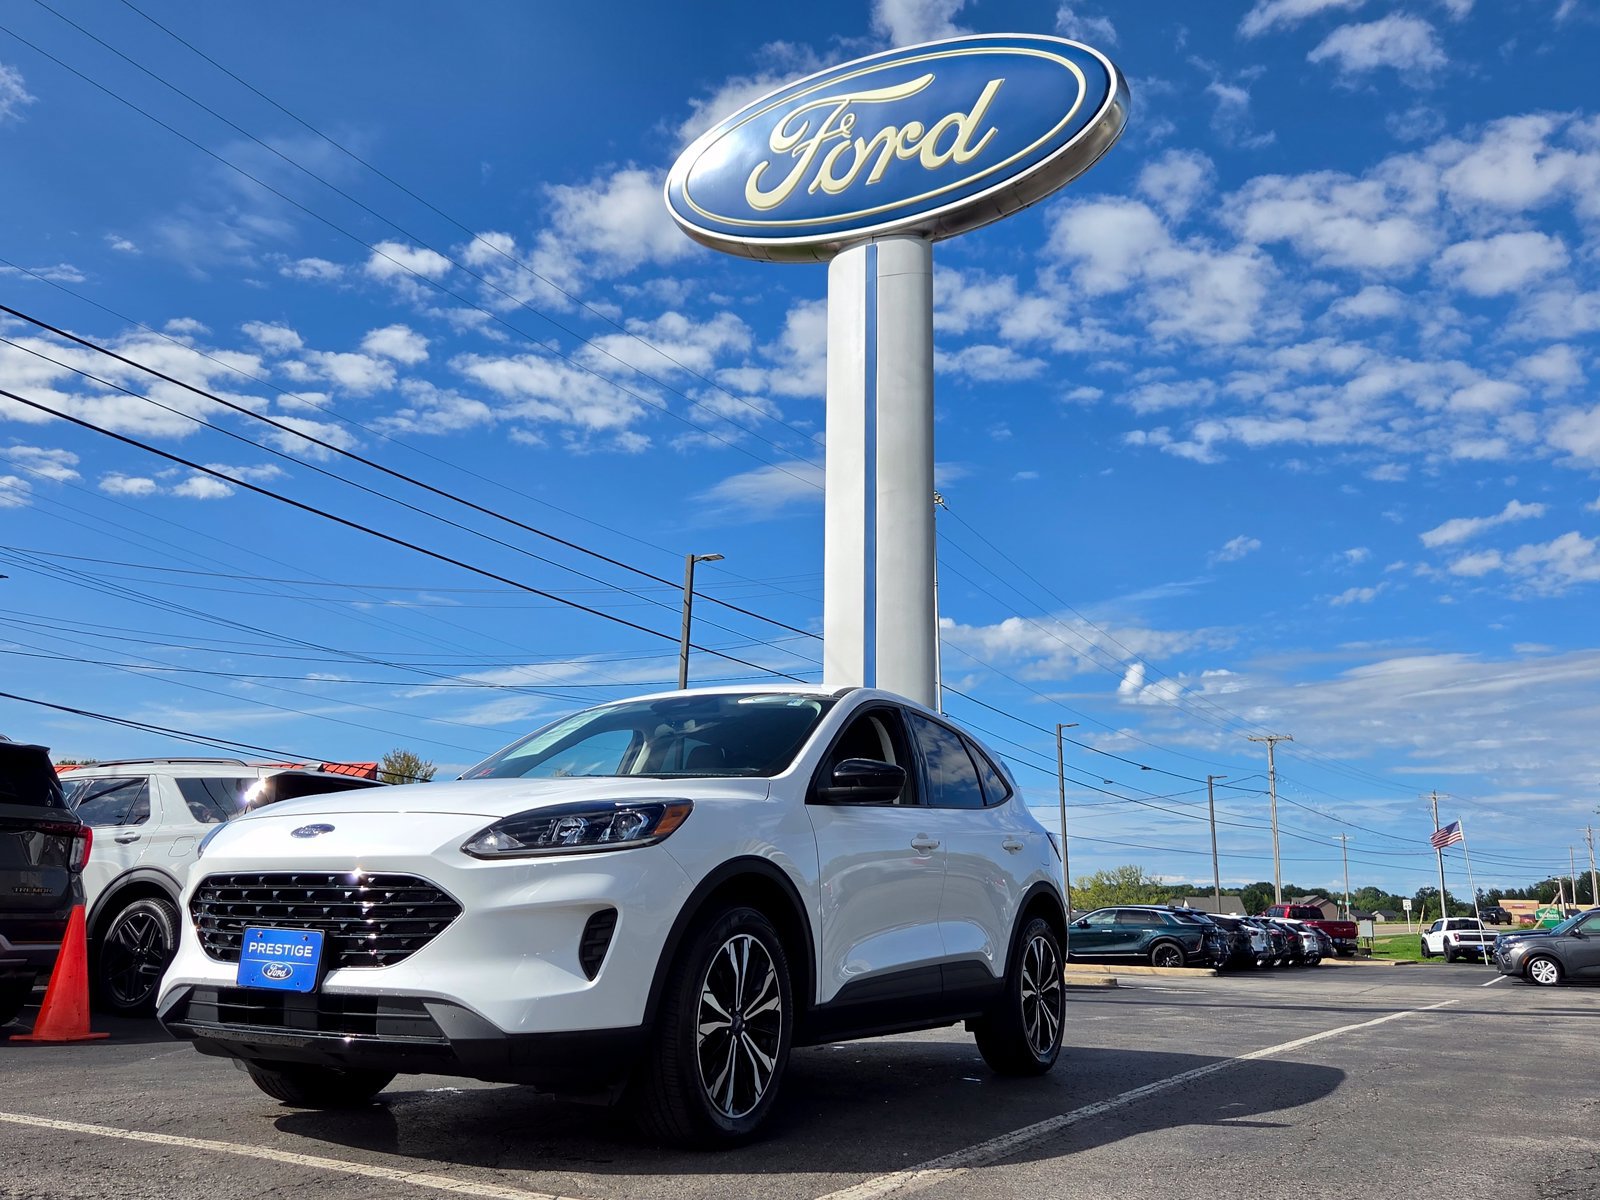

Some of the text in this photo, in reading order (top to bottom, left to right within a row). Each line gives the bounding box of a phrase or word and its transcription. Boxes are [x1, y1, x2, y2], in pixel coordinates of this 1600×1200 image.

[745, 73, 1005, 210] Ford
[248, 942, 313, 957] PRESTIGE
[266, 963, 287, 978] Ford
